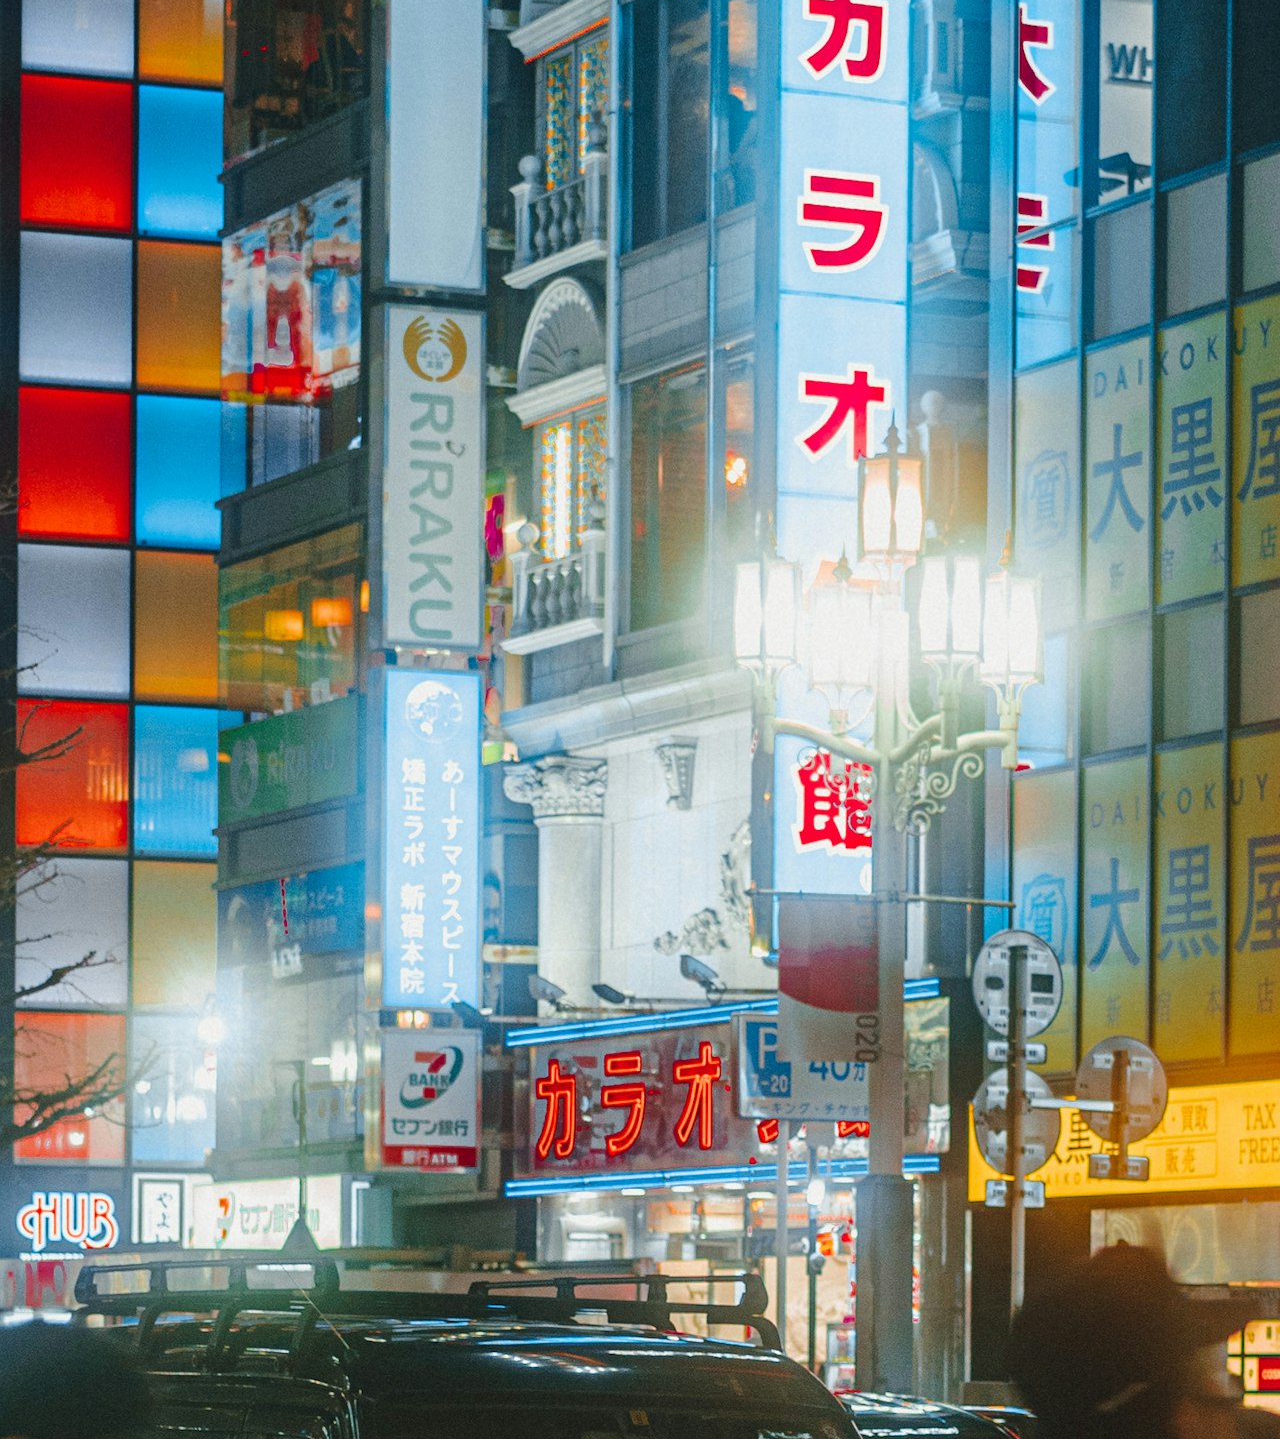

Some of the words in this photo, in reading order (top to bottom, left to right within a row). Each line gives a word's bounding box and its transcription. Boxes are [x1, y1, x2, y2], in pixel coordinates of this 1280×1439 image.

[401, 757, 428, 868] 矯正ラボ
[440, 759, 465, 1006] あーすマウスピース
[399, 881, 428, 996] 新宿本院
[758, 1027, 778, 1069] P
[408, 1072, 452, 1087] BANK
[751, 1073, 788, 1093] 7-20
[391, 1117, 469, 1138] セブン銀行
[1241, 1102, 1277, 1131] TAX
[1164, 1147, 1197, 1175] 販売
[17, 1190, 119, 1252] HUB
